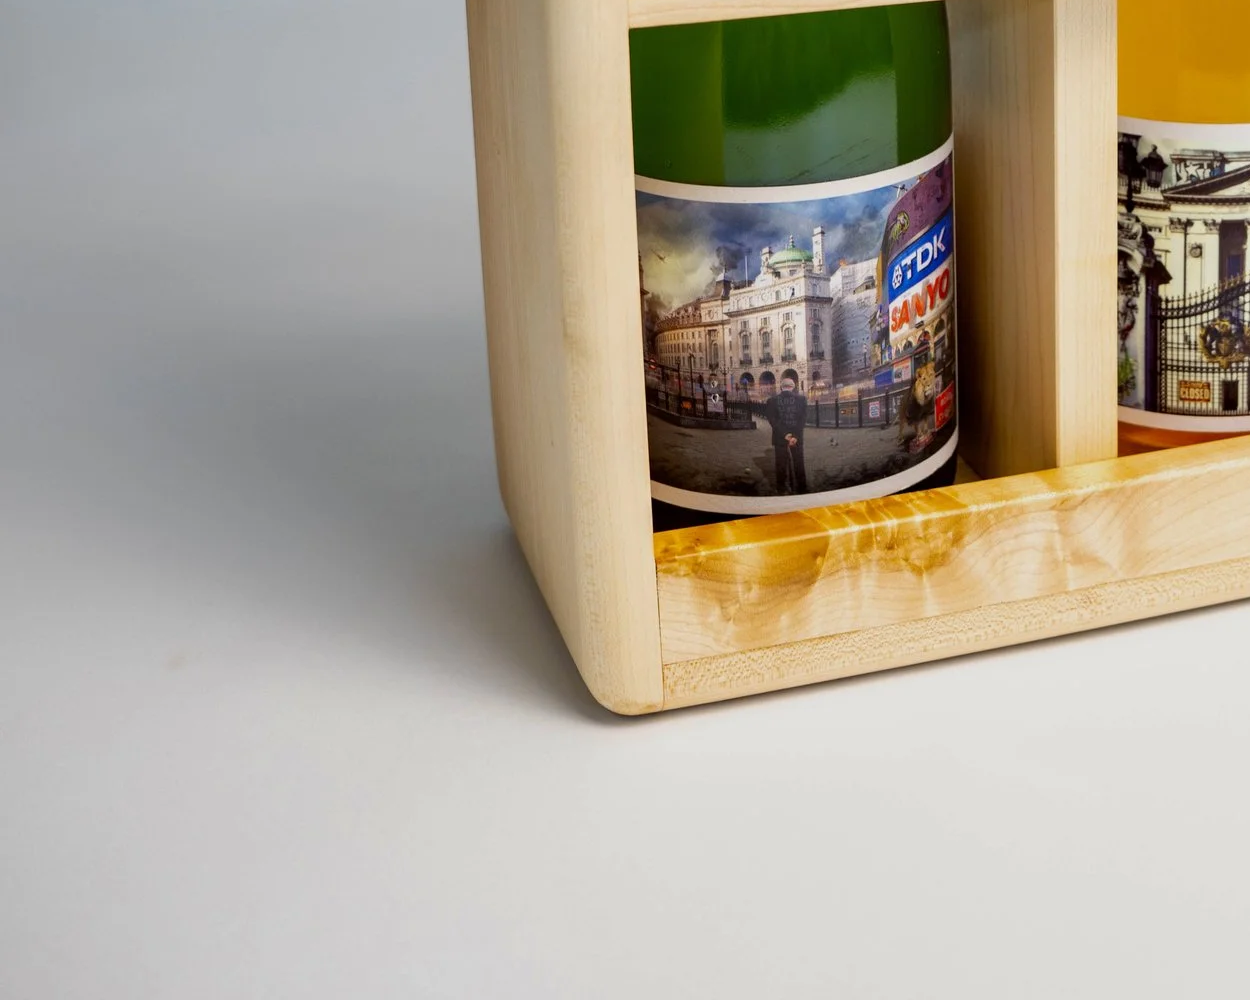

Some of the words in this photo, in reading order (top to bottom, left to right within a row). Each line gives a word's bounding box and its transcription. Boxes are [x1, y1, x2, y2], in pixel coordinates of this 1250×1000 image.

[902, 226, 946, 280] TDK
[891, 267, 950, 333] SANYO
[1179, 387, 1210, 399] CLOSED
